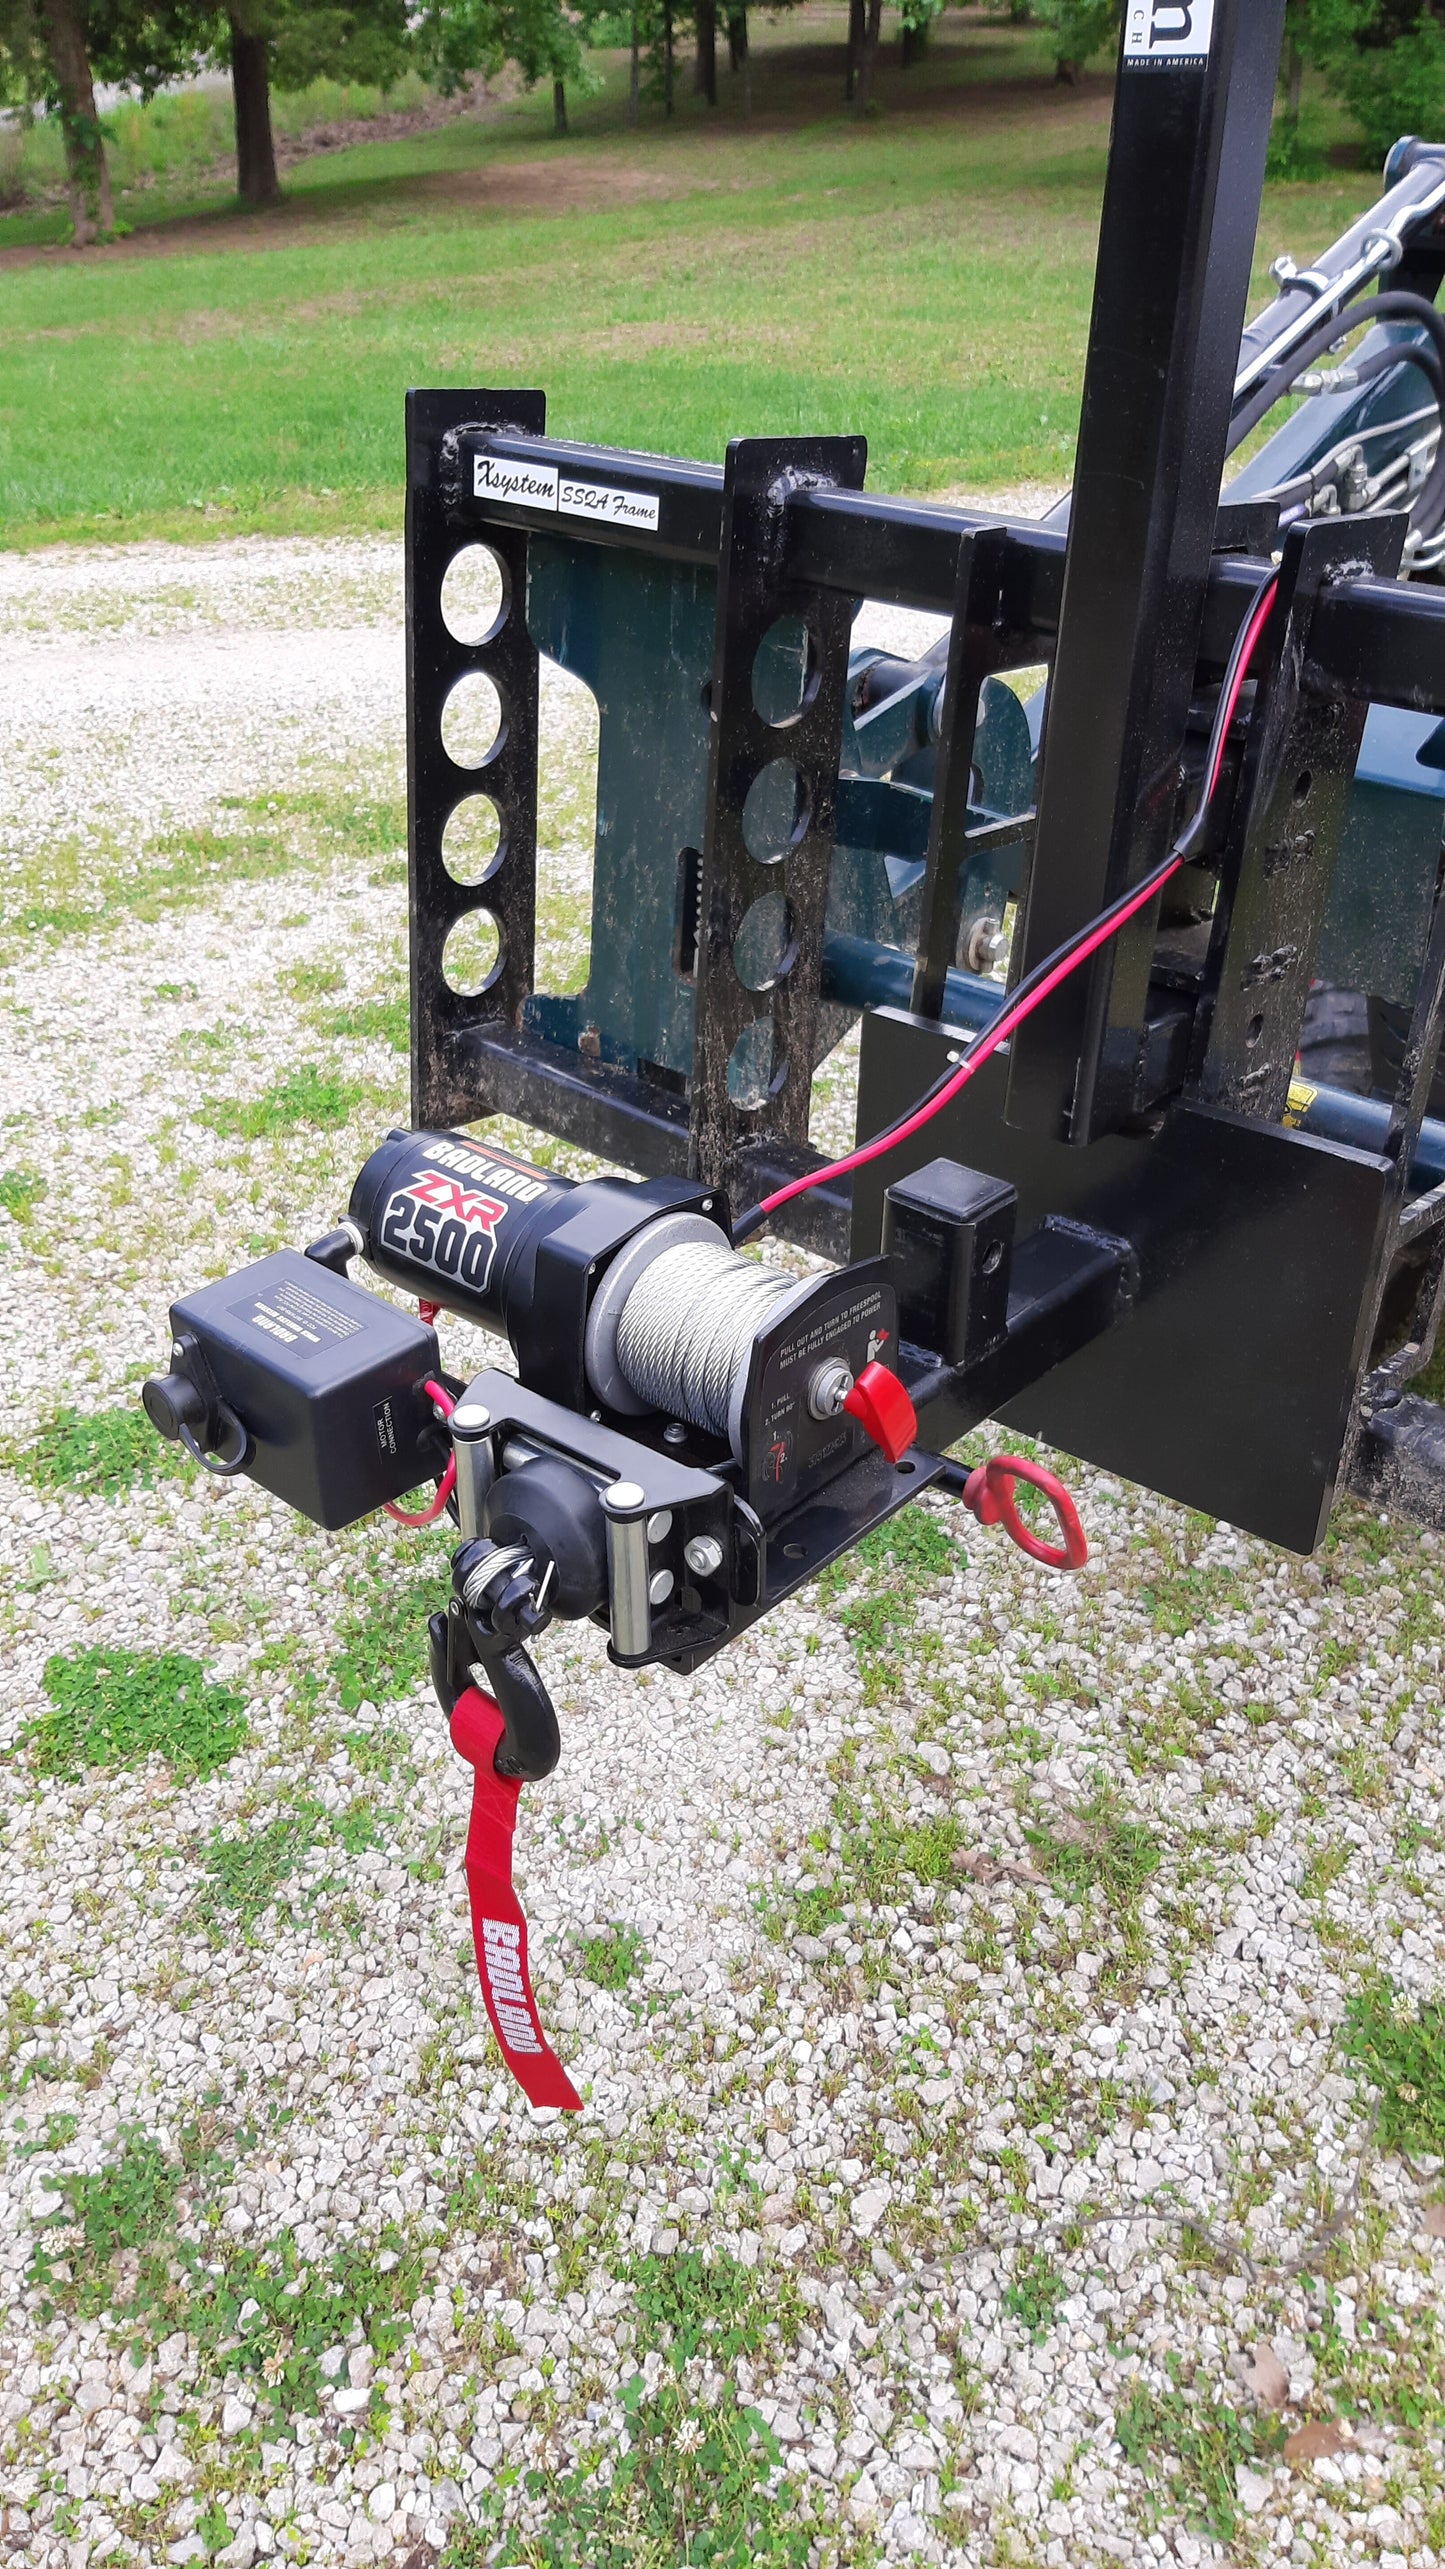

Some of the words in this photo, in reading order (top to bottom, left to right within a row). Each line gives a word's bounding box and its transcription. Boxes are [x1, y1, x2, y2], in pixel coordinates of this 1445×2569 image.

[1127, 58, 1150, 67] MADE
[1153, 58, 1162, 66] IN
[1166, 57, 1204, 66] AMERICA
[477, 460, 555, 498] Xsystem
[612, 496, 656, 519] Frame
[422, 1141, 549, 1203] BADLAND
[409, 1172, 505, 1232] ZXR
[383, 1194, 494, 1288] 2500
[252, 1314, 298, 1343] BADLAND
[780, 1344, 795, 1358] PULL
[796, 1334, 808, 1346] OUT
[810, 1326, 822, 1339] AND
[824, 1315, 840, 1330] TURN
[841, 1310, 848, 1320] TO
[849, 1290, 881, 1315] FREESPOOL
[780, 1353, 797, 1370] MUST
[798, 1348, 806, 1358] BE
[807, 1336, 824, 1353] FULLY
[825, 1320, 851, 1341] ENGAGED
[852, 1315, 860, 1325] TO
[860, 1302, 881, 1320] POWER
[771, 1408, 785, 1422] TURN
[776, 1392, 790, 1407] PULL
[377, 1417, 387, 1448] MOTOR
[383, 1402, 397, 1454] CONNECTION
[481, 1916, 543, 2054] BADLAND
